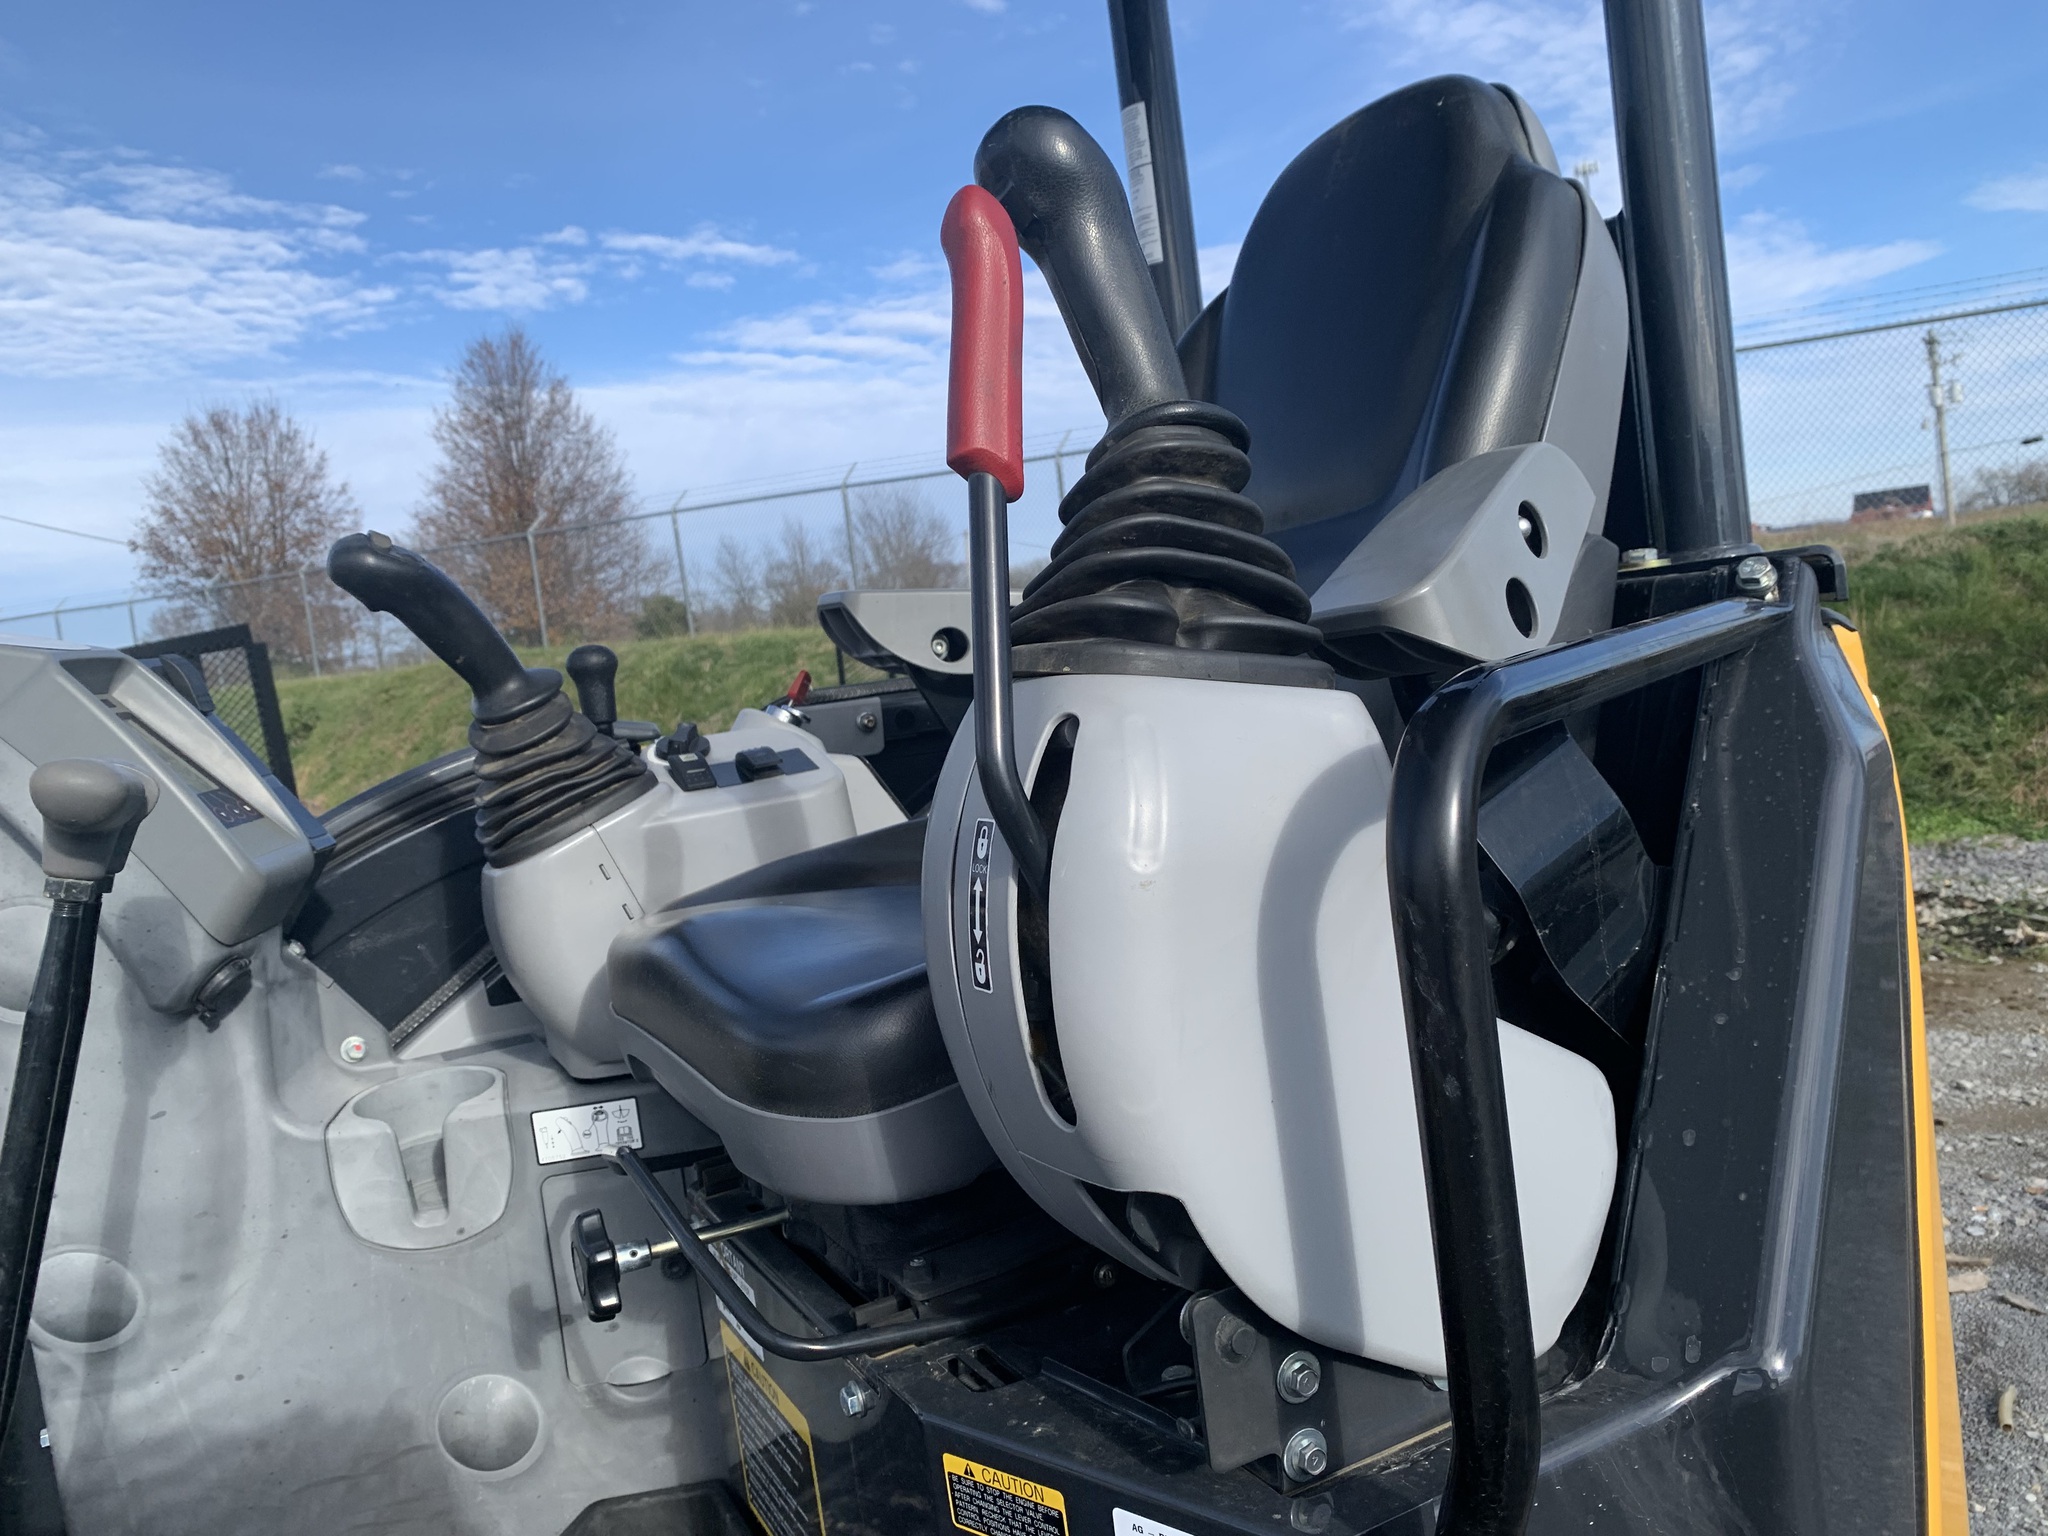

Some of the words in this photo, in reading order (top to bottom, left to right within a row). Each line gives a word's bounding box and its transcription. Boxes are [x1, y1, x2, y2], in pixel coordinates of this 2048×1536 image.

[972, 863, 988, 873] LOCK
[953, 1483, 982, 1498] OPERATING
[984, 1492, 994, 1503] THE
[997, 1498, 1024, 1513] SELECTOR
[961, 1477, 974, 1488] SURE
[977, 1483, 984, 1491] TO
[986, 1486, 1000, 1496] STOP
[1003, 1491, 1013, 1501] THE
[1016, 1496, 1035, 1510] ENGINE
[1038, 1505, 1059, 1518] BEFORE
[981, 1468, 1044, 1502] CAUTION
[955, 1492, 971, 1502] AFTER
[972, 1498, 1000, 1513] CHANGING
[1002, 1509, 1012, 1517] THE
[1015, 1512, 1032, 1524] LEVER
[1034, 1520, 1060, 1535] CONTROL
[957, 1507, 980, 1521] CONTROL
[983, 1517, 1010, 1533] POSITIONS
[958, 1516, 988, 1533] CORRECTLY
[982, 1508, 1006, 1523] RECHECK
[1009, 1518, 1022, 1531] THAT
[1025, 1525, 1035, 1534] THE
[1132, 1523, 1144, 1534] AG
